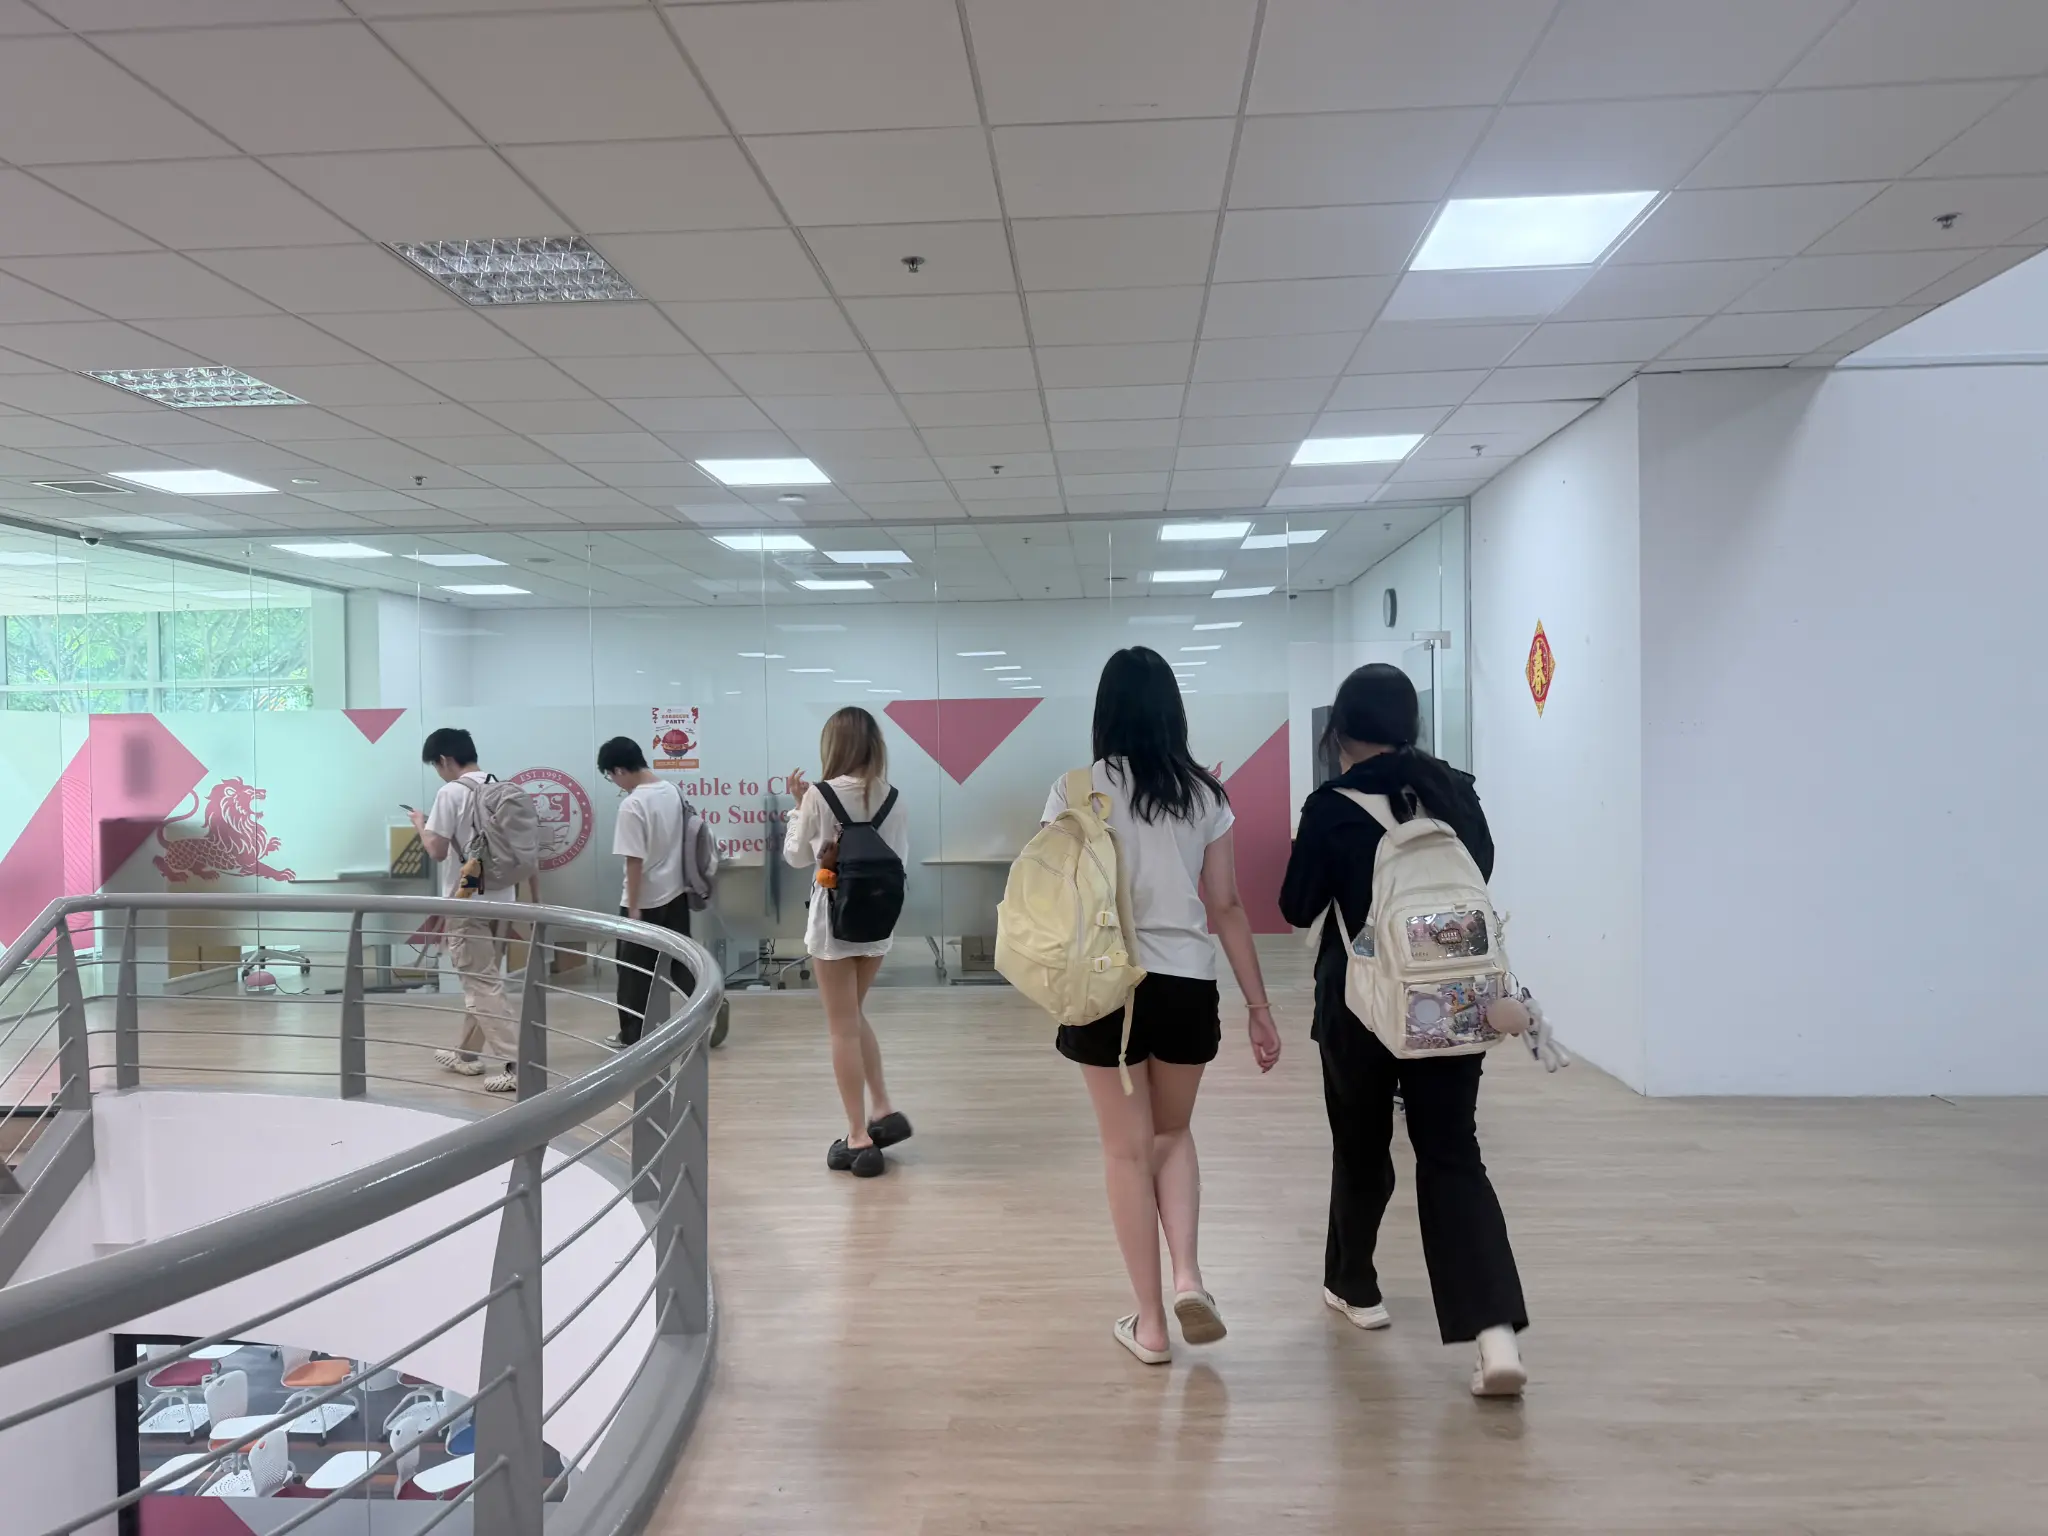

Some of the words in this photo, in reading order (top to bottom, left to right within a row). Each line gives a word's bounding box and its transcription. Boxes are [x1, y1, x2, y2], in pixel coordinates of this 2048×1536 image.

[1532, 641, 1547, 694] 春
[678, 778, 732, 796] table
[738, 778, 759, 796] to
[700, 808, 721, 825] to
[728, 805, 790, 825] Succe
